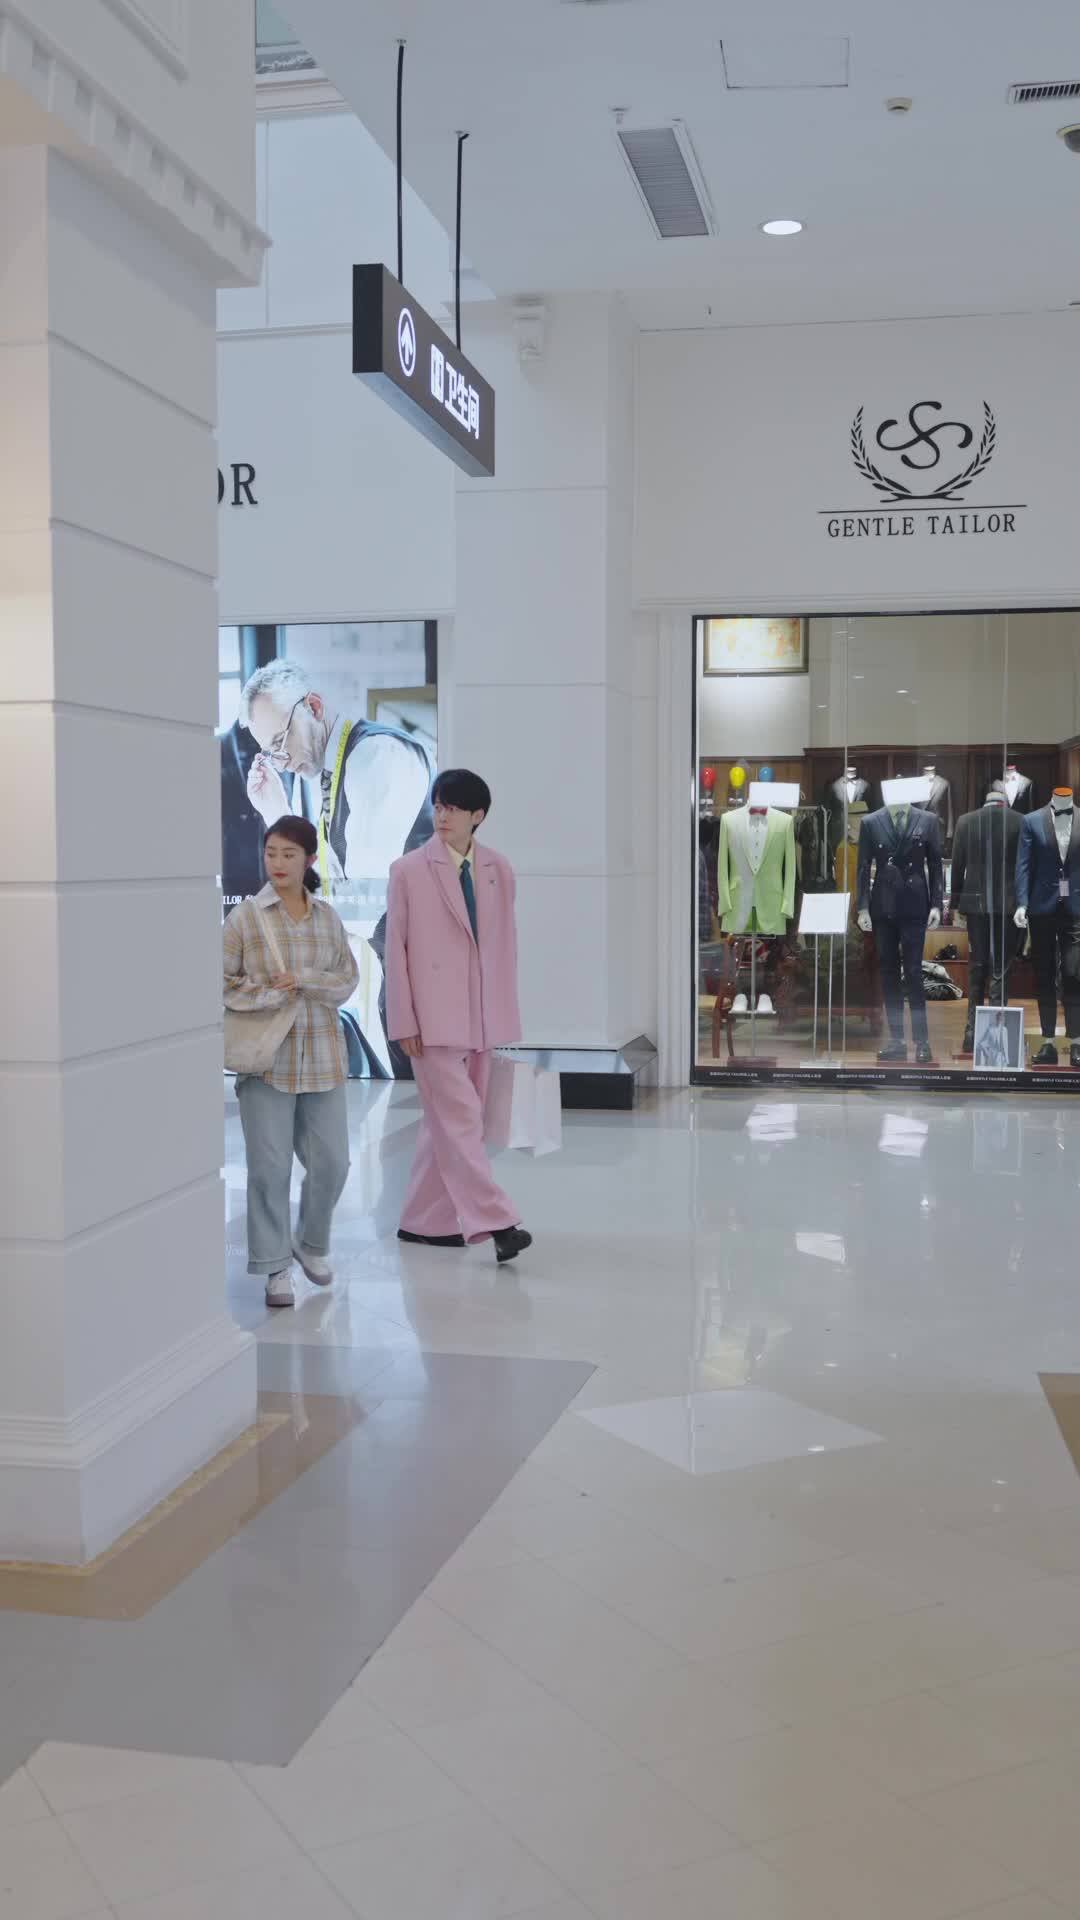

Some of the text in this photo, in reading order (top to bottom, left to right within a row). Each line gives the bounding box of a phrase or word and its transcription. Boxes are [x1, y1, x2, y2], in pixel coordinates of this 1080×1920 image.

[444, 360, 480, 440] 卫生间
[827, 513, 1016, 538] GENTLE TAILOR
